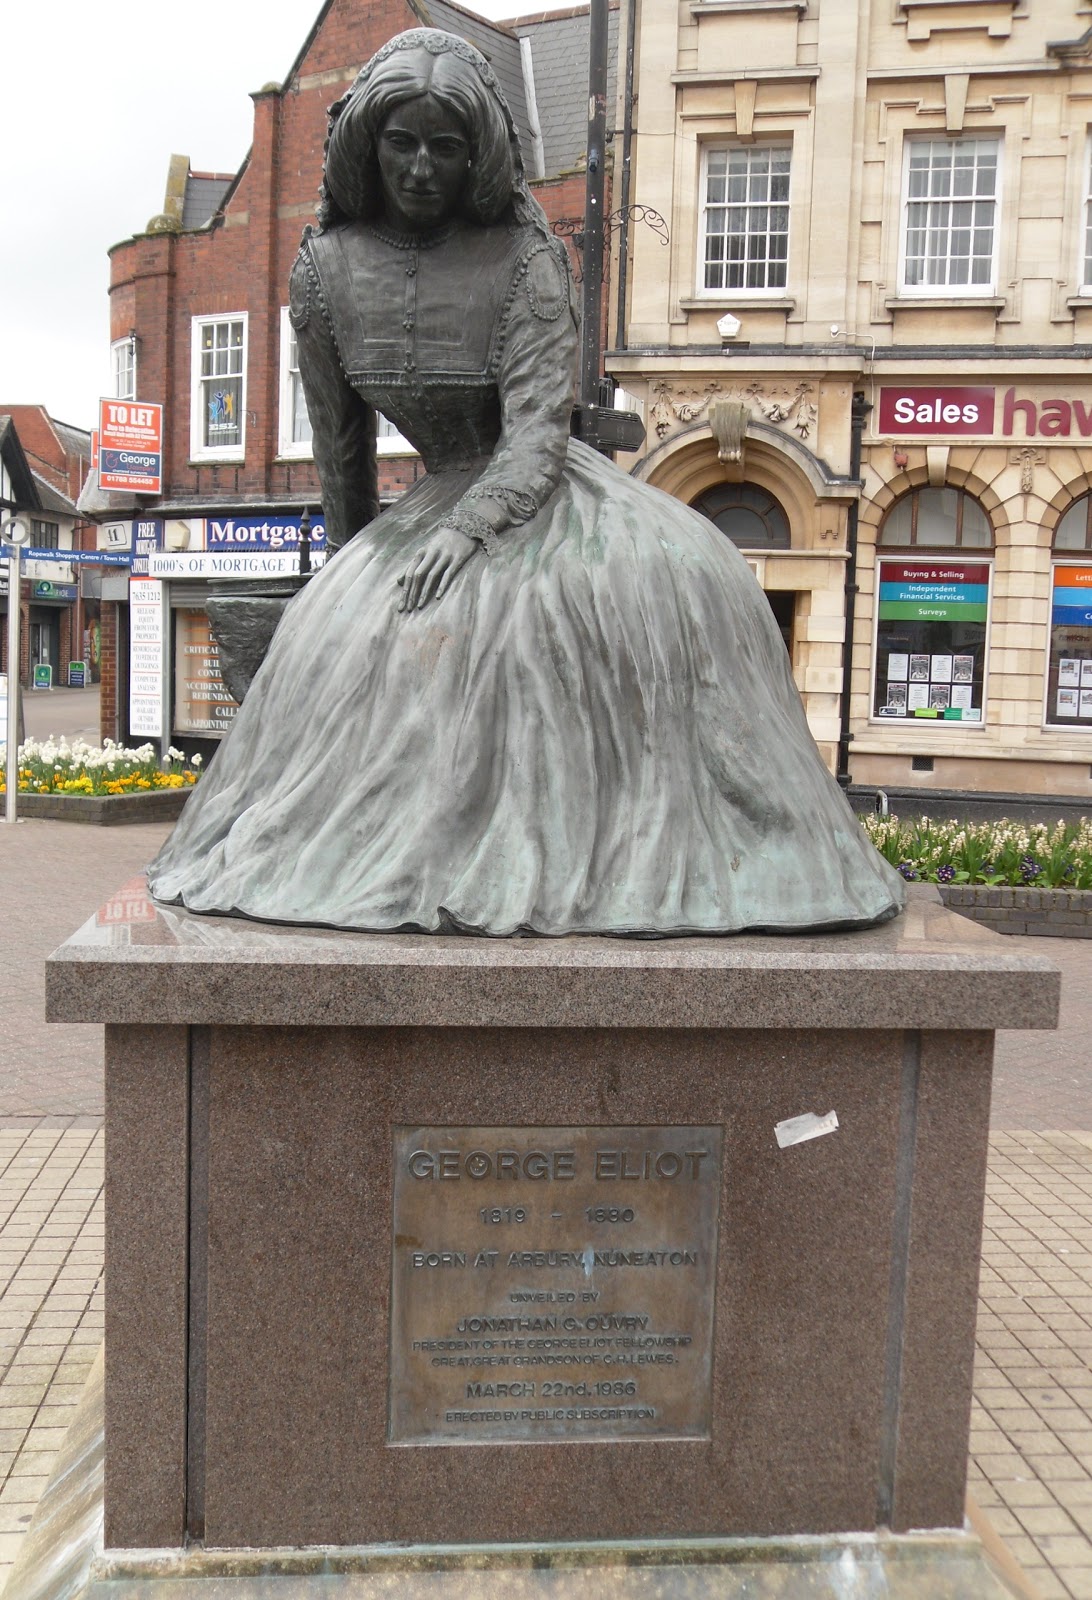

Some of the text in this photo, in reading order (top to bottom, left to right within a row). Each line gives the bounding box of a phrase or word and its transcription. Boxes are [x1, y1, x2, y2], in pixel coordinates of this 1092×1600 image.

[108, 405, 154, 426] TO LET
[894, 397, 979, 424] Sales
[119, 452, 156, 467] George
[138, 522, 155, 537] FREE
[55, 552, 79, 560] Shopping
[153, 559, 184, 571] 1000's
[189, 559, 205, 571] OF
[211, 559, 285, 571] MORTGAGE
[903, 570, 929, 579] Buying
[939, 571, 965, 580] Selling
[140, 582, 153, 590] TEL:
[908, 585, 957, 593] Independent
[147, 591, 161, 601] 1212
[918, 608, 947, 617] Surveys
[408, 1150, 708, 1181] GEORGE ELIOT
[480, 1208, 526, 1224] 1819
[586, 1207, 635, 1223] 1880
[412, 1252, 467, 1268] BORN
[473, 1251, 499, 1267] AT
[593, 1251, 697, 1267] NUNEATON
[510, 1292, 599, 1303] UNVEILED BY
[457, 1315, 649, 1333] JONATHAN G. OUVRY
[412, 1336, 692, 1351] PRESIDENT OF THE GEORGE ELIOT FELLOWSHIP
[513, 1355, 581, 1366] GRANDSON
[583, 1355, 600, 1364] OF
[466, 1384, 536, 1399] MARCH
[446, 1408, 655, 1422] ERECTED BY PUBLIC SUBSCRIPTION
